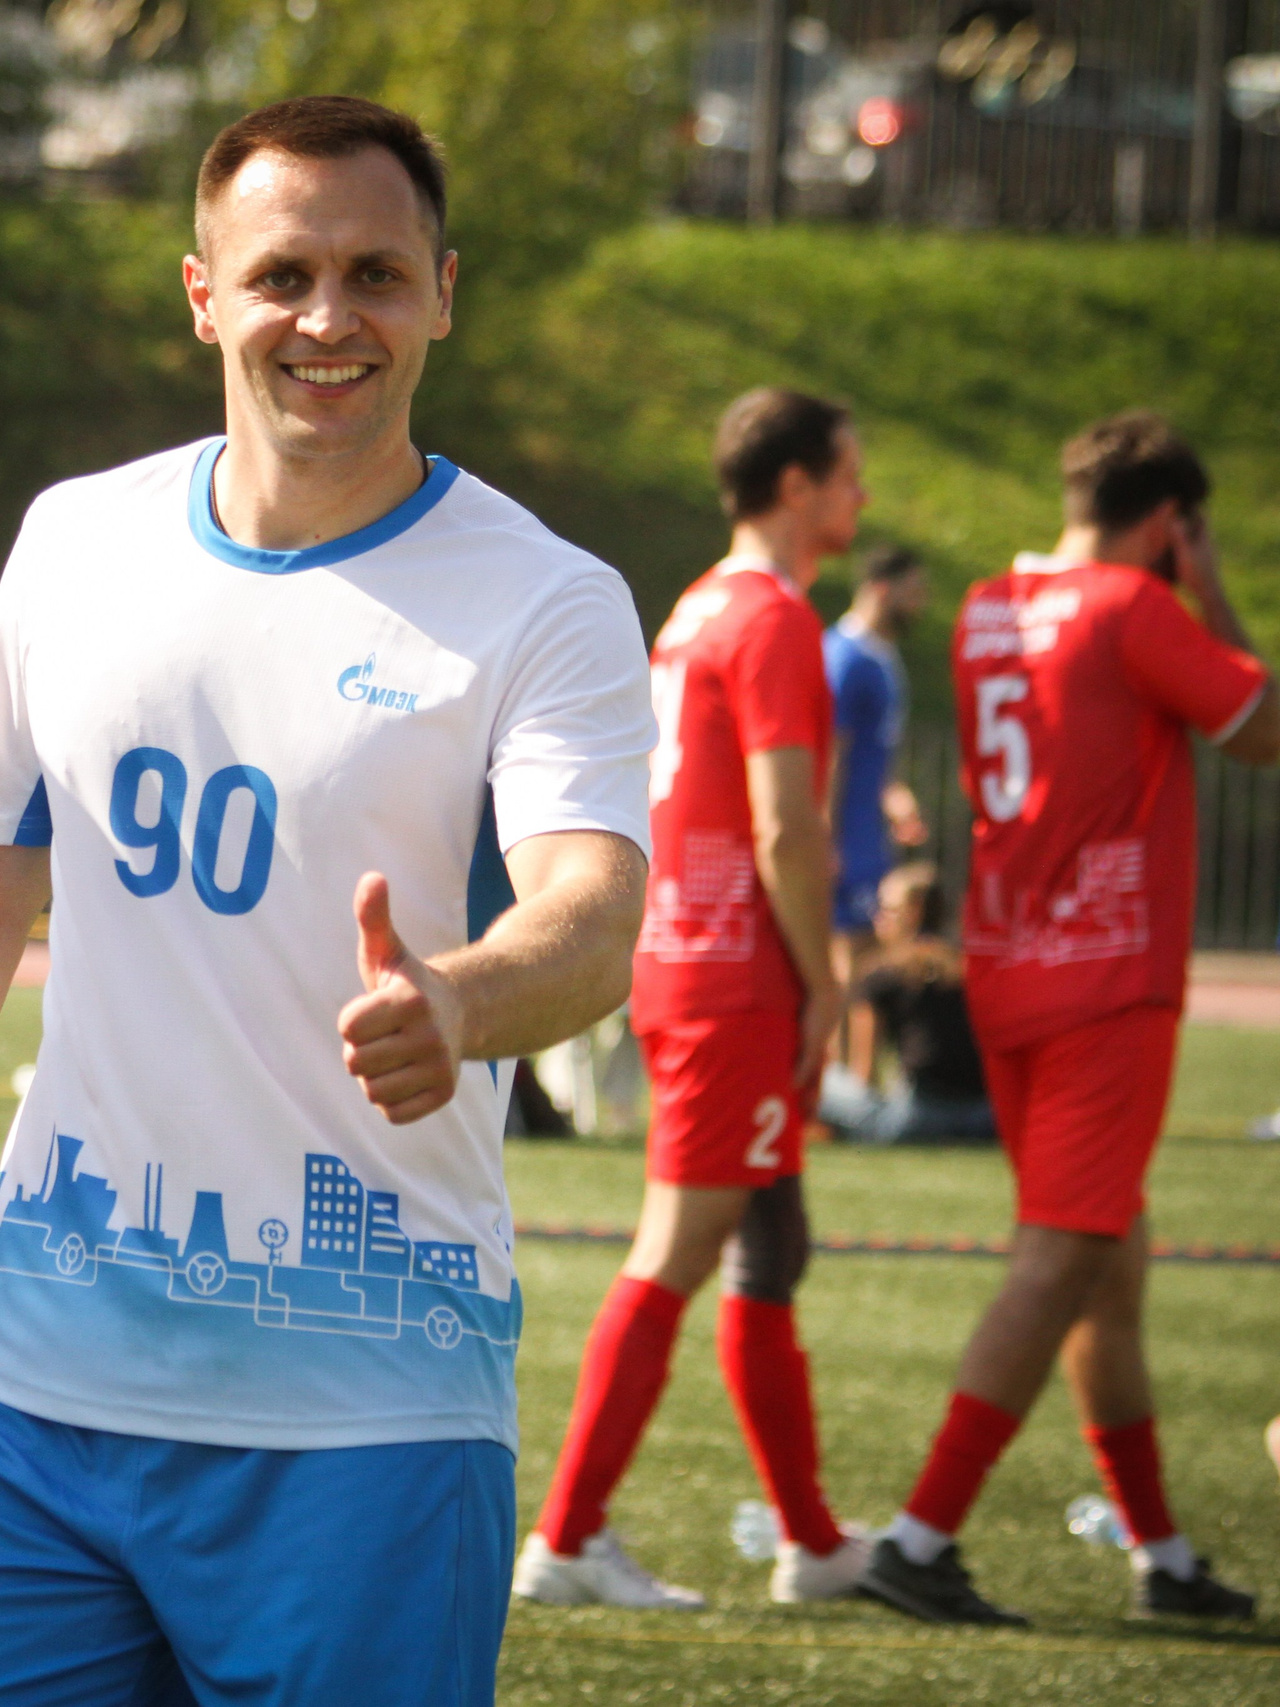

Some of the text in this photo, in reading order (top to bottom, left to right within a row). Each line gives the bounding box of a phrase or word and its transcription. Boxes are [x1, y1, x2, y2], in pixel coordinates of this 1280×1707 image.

[976, 673, 1031, 823] 5
[109, 746, 278, 916] 90
[745, 1096, 788, 1169] 2
